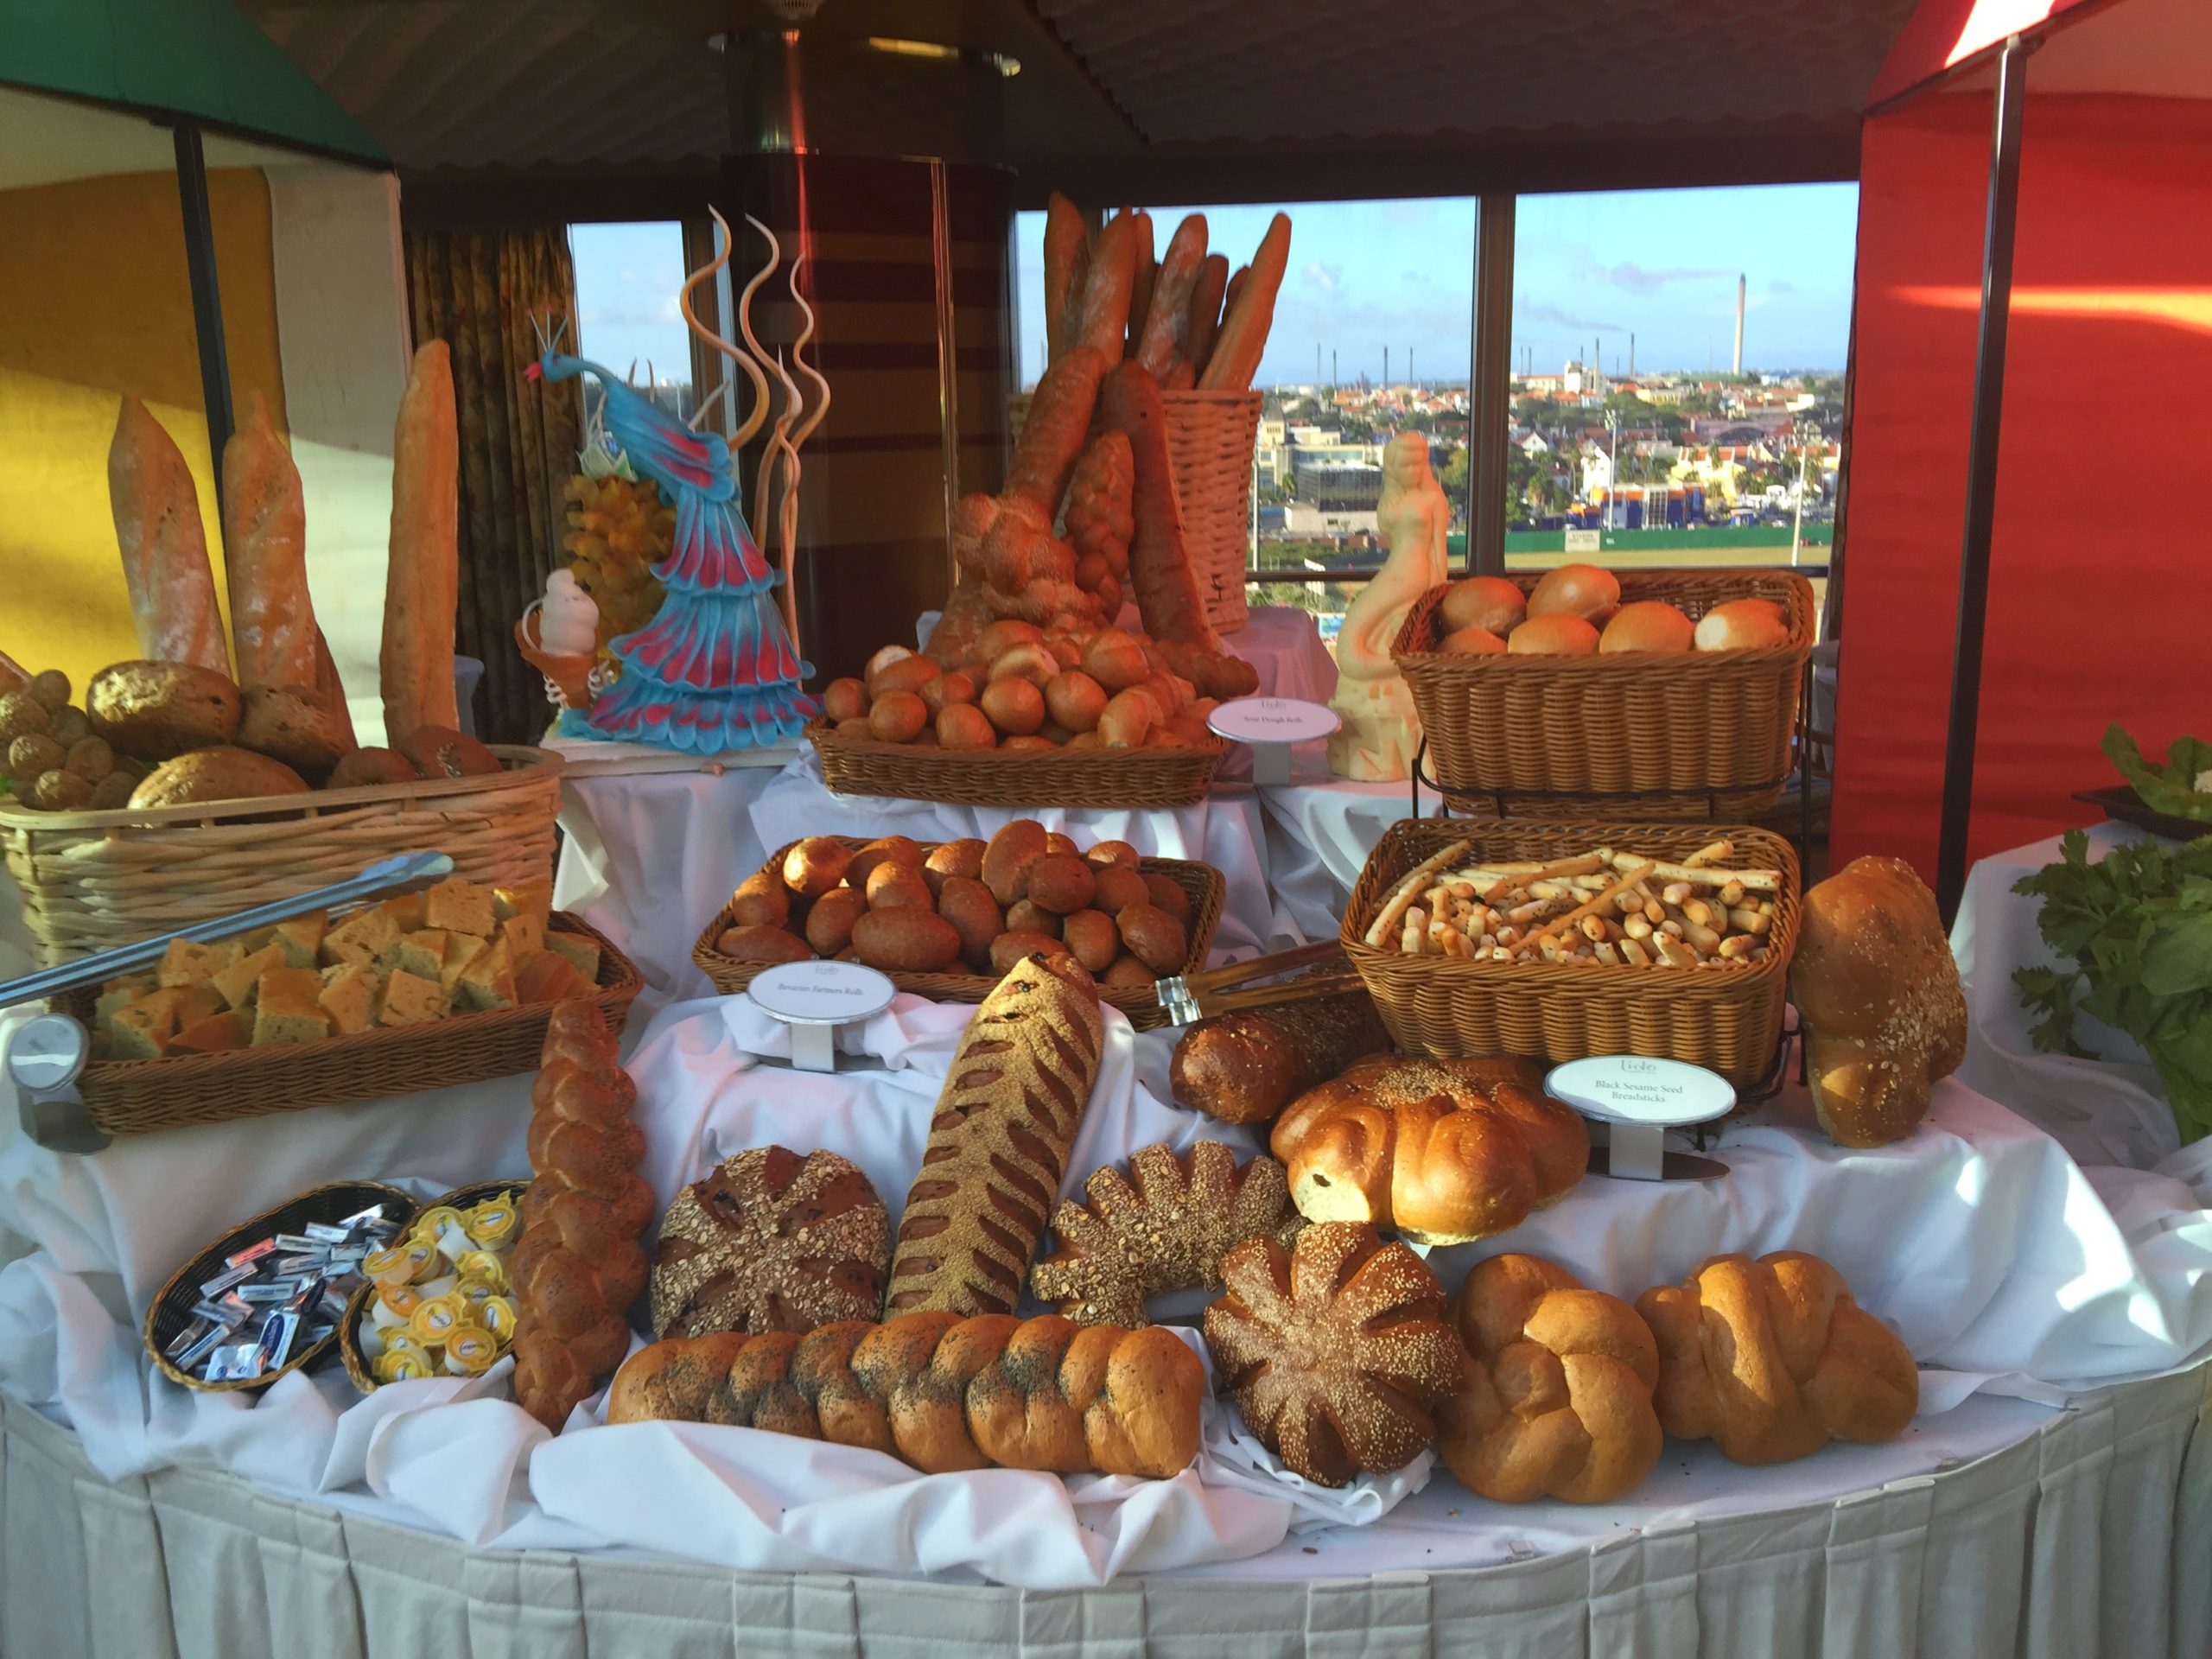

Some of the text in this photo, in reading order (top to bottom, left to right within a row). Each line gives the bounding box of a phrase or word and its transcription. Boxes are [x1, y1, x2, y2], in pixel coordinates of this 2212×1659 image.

[1595, 1080, 1683, 1094] Black Sesame Seed
[1611, 1091, 1666, 1103] Breadsticks
